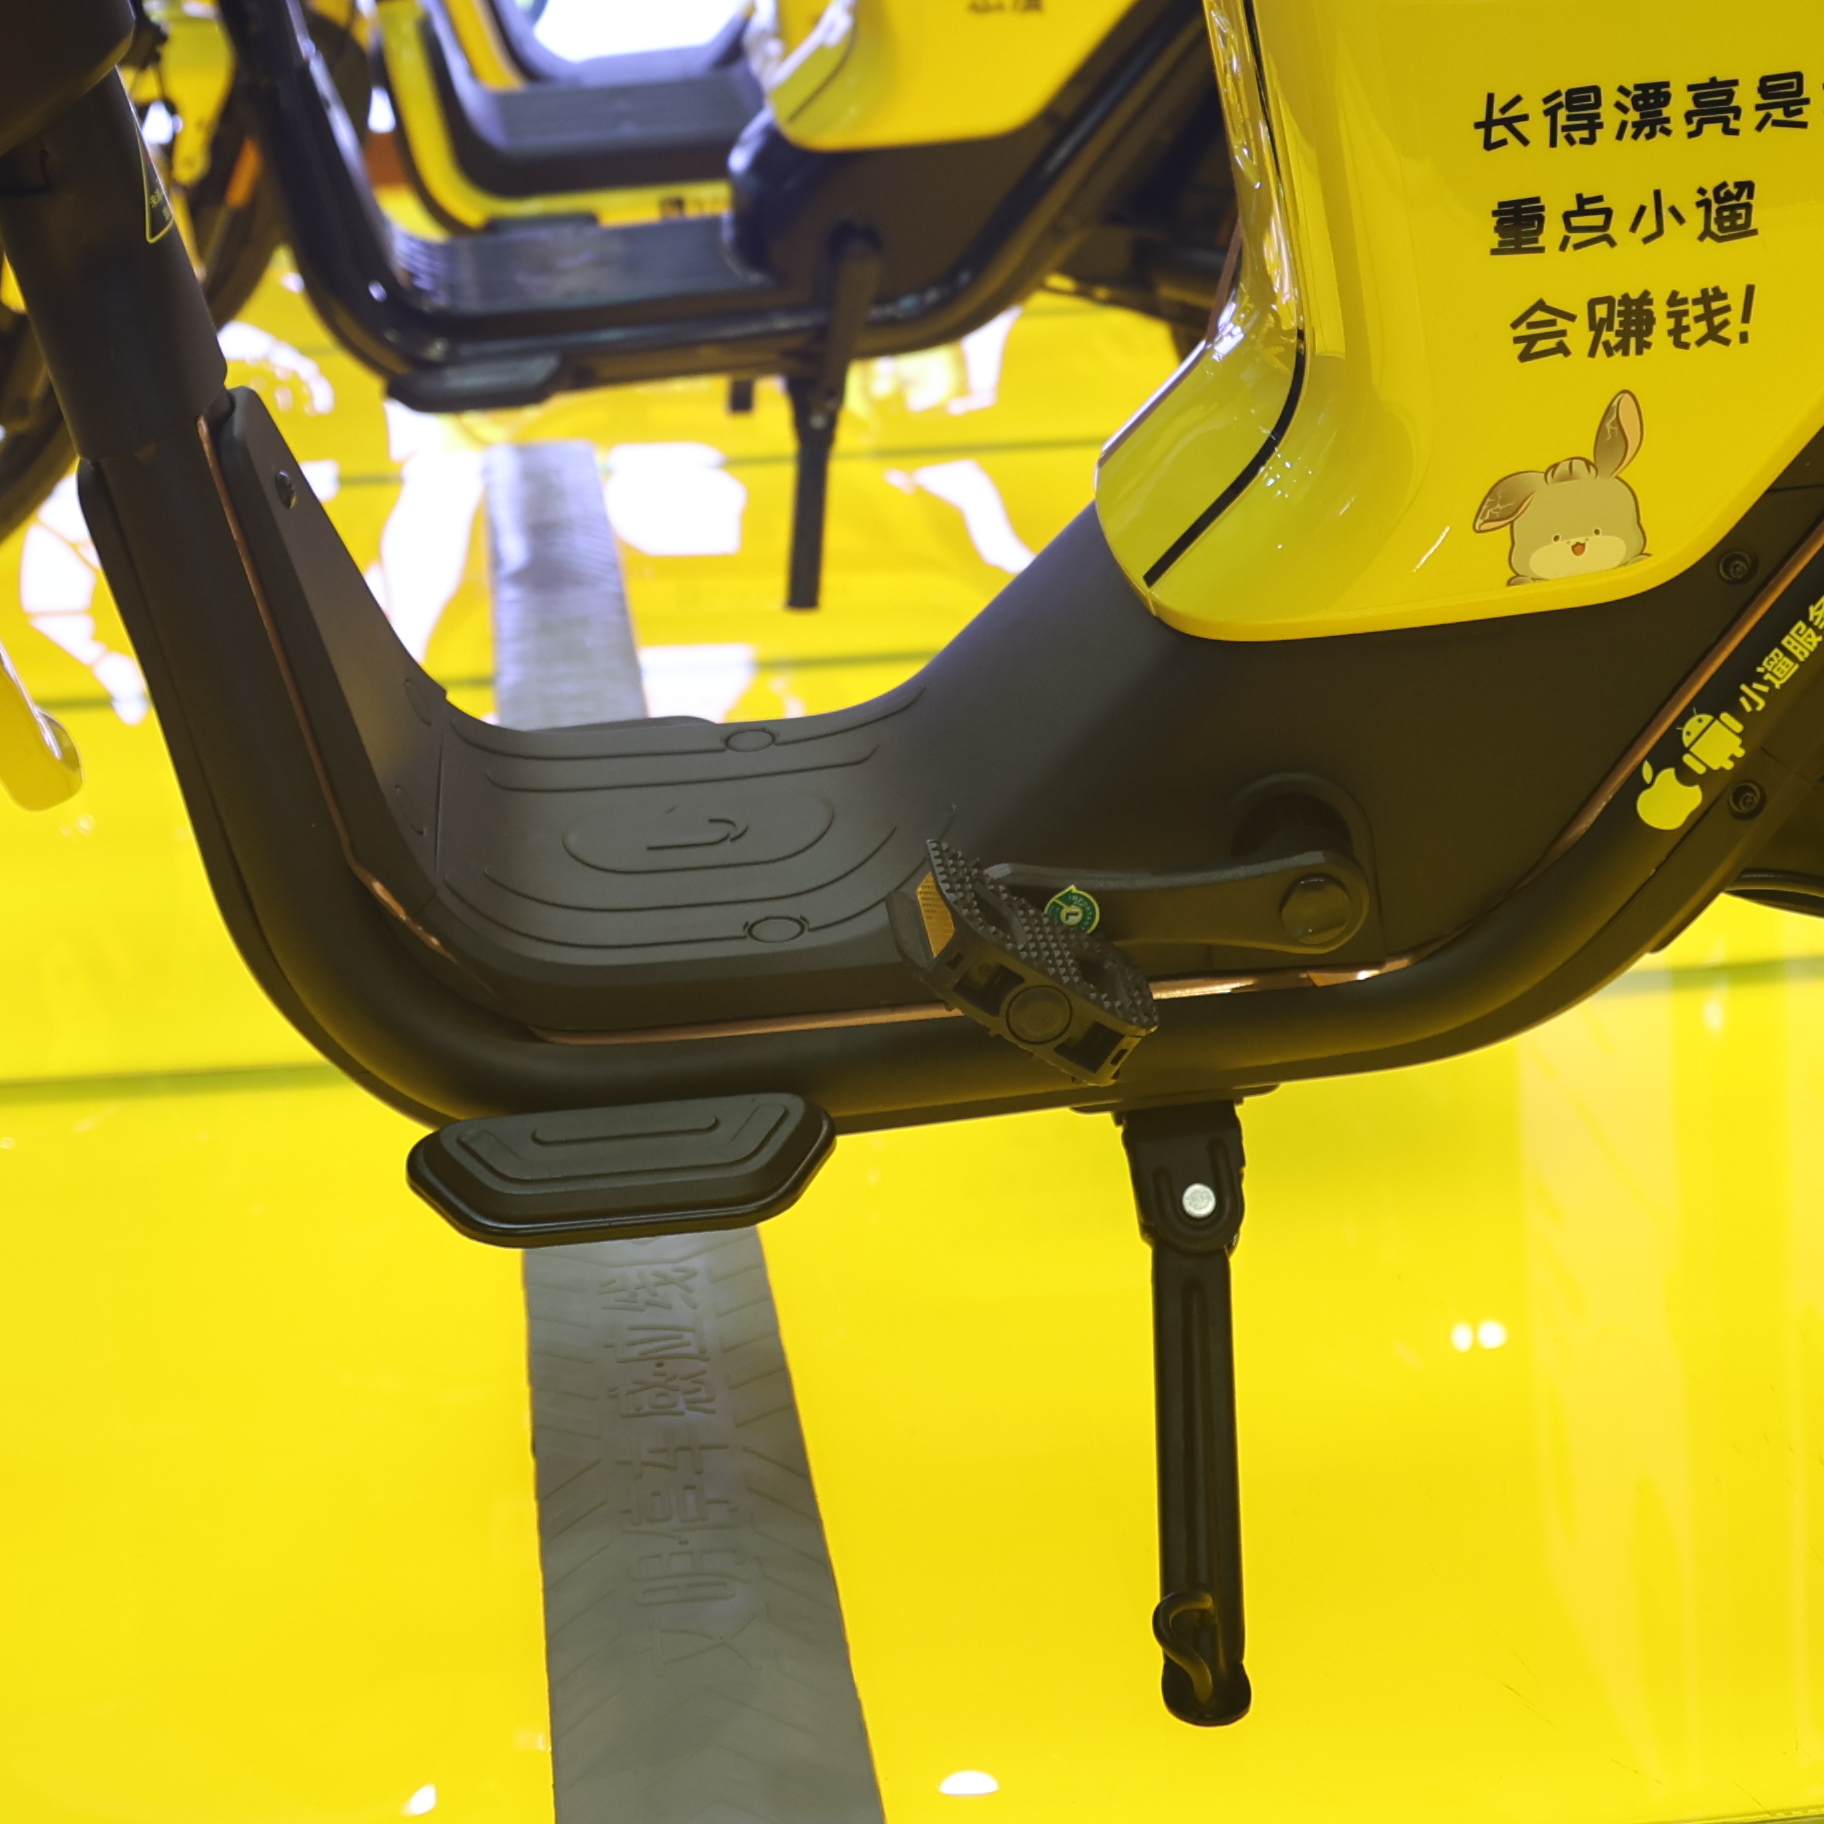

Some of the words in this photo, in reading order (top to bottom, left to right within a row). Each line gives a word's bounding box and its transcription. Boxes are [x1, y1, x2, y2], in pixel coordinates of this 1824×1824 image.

[1489, 180, 1759, 257] 重点小遛
[1509, 284, 1756, 364] 会赚钱!
